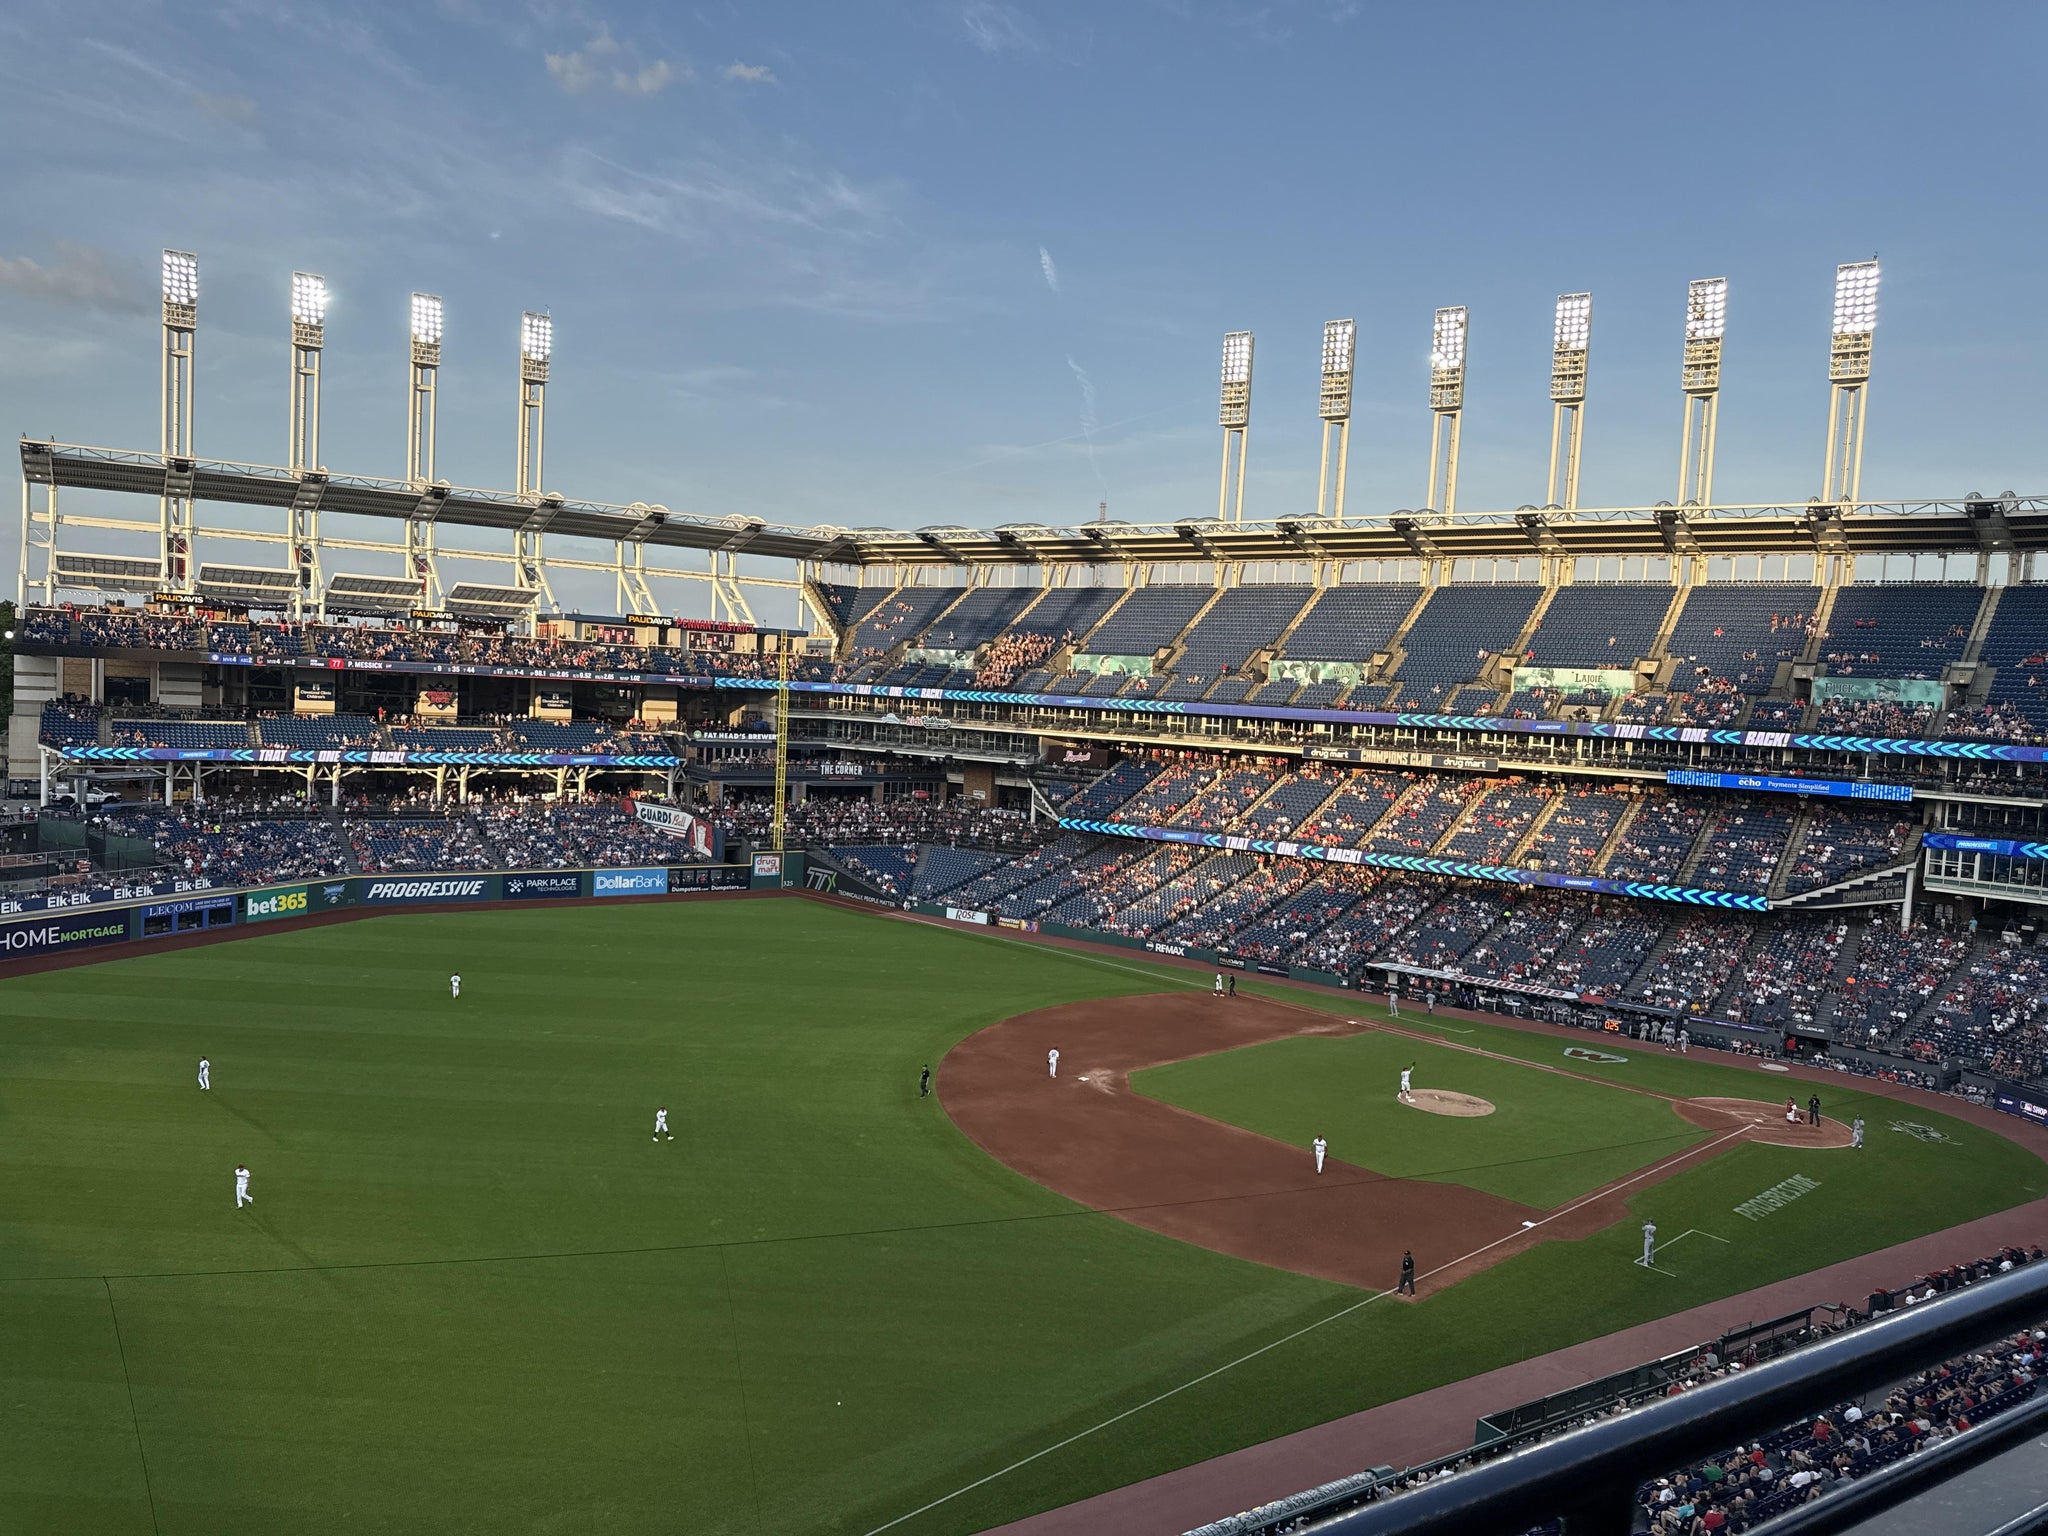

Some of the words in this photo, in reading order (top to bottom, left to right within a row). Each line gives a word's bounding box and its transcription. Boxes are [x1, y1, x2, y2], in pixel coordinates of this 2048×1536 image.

[676, 617, 715, 631] PENNANT
[717, 621, 755, 633] DISTRICT
[347, 660, 354, 668] P.
[354, 661, 383, 669] MESSICK
[855, 684, 873, 695] THAT
[889, 686, 903, 697] ONE
[920, 688, 943, 699] BACK!
[719, 732, 746, 740] HEAD'S
[1614, 724, 1646, 739] THAT
[1680, 727, 1709, 742] ONE
[1745, 730, 1791, 747] BACK!
[259, 750, 287, 762] THAT
[318, 750, 341, 762] ONE
[371, 750, 405, 763] BACK!
[1311, 748, 1329, 759] drug
[1330, 750, 1349, 759] mart
[1361, 749, 1409, 766] CHAMPIONS
[1410, 752, 1432, 767] CLUB
[1443, 757, 1464, 769] drug
[1465, 760, 1486, 768] mart
[820, 764, 834, 775] THE
[835, 765, 863, 776] CORNER
[1798, 782, 1830, 791] Simplified
[640, 807, 672, 825] GUARDS
[1225, 836, 1250, 850] THAT
[1277, 841, 1299, 856] ONE
[1327, 847, 1363, 864] BACK!
[756, 855, 776, 867] drug
[526, 879, 549, 888] PARK
[550, 877, 577, 887] PLACE
[367, 880, 485, 899] PROGRESSIVE
[247, 892, 308, 916] bet365
[955, 909, 976, 920] ROSE
[0, 926, 60, 951] HOME
[60, 924, 124, 943] MORTGAGE
